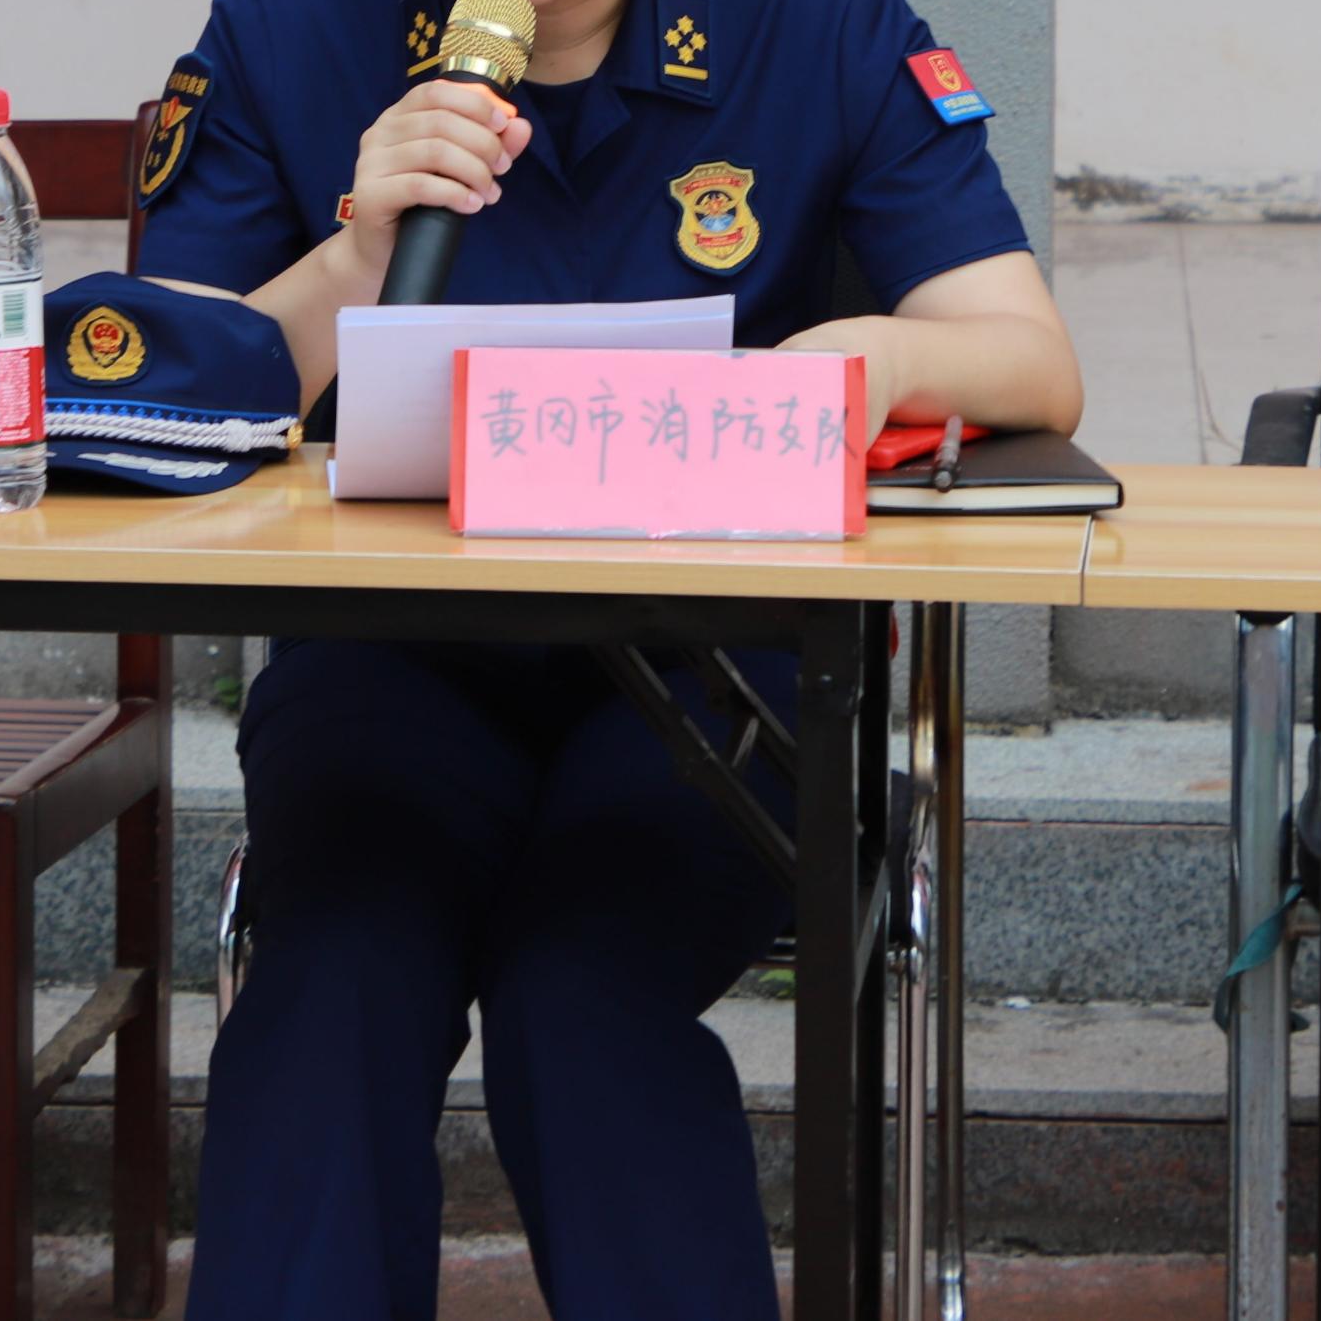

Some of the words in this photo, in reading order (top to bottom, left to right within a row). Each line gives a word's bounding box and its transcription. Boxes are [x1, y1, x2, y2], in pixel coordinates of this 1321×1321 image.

[481, 377, 858, 483] 黄冈市消防支队
